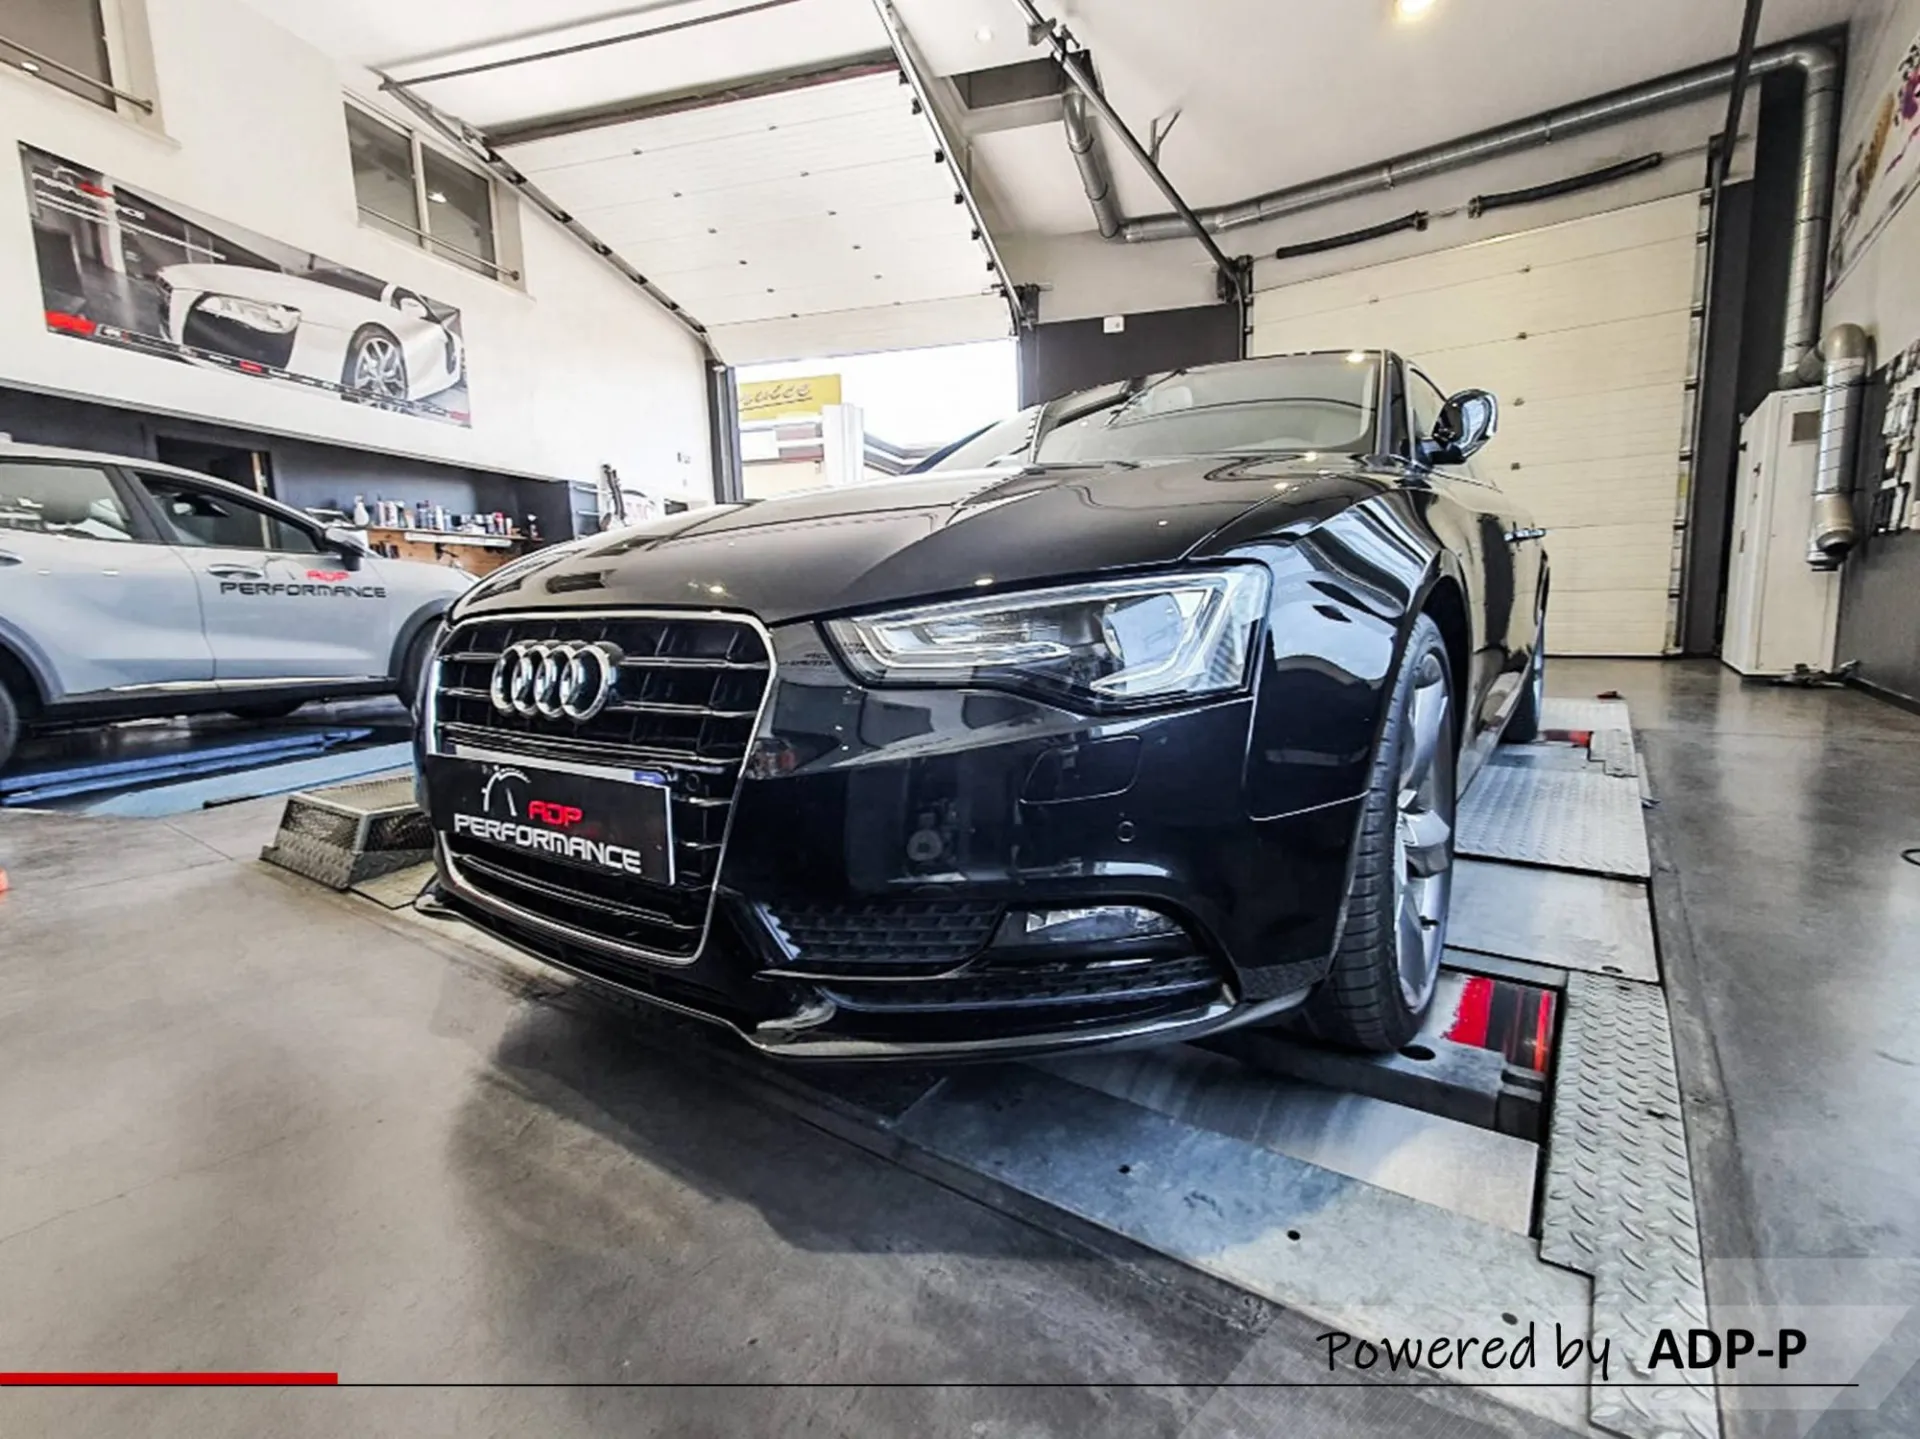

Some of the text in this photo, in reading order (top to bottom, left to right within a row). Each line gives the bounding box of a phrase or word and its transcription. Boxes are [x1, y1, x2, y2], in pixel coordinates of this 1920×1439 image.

[219, 581, 387, 598] PERFORMANCE
[527, 799, 584, 827] ADP
[453, 812, 642, 874] PERFORMANCE
